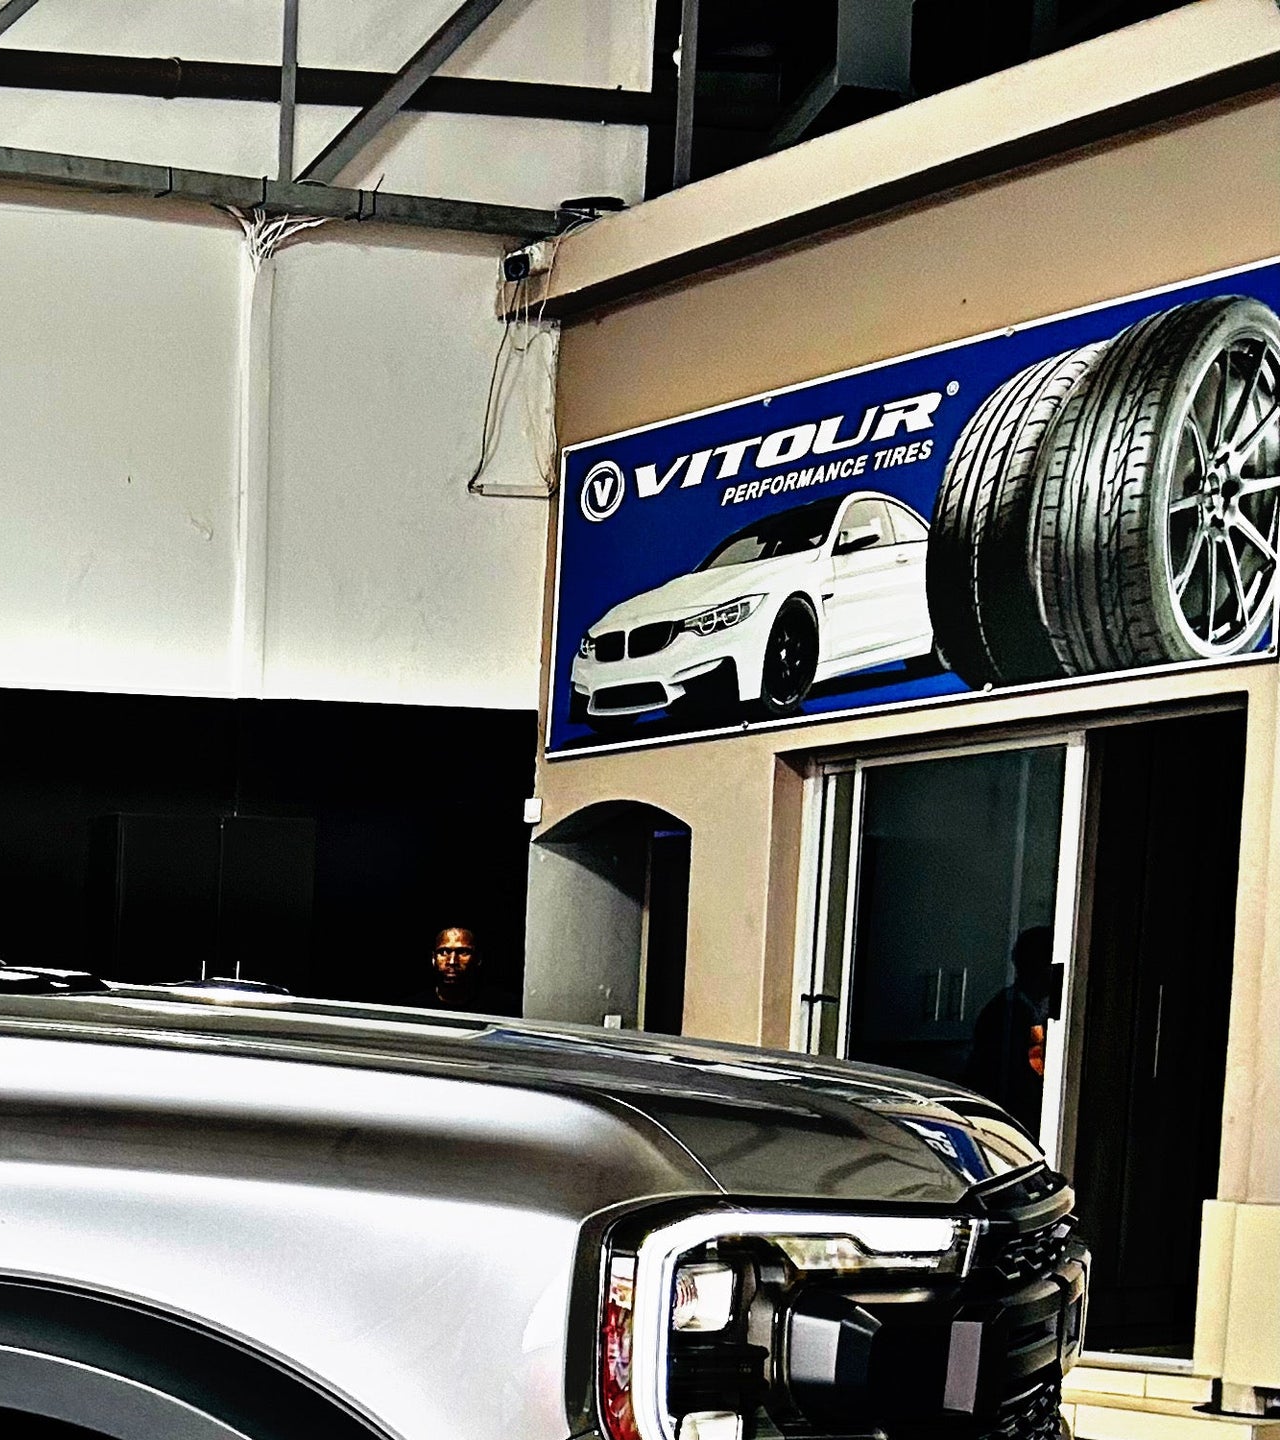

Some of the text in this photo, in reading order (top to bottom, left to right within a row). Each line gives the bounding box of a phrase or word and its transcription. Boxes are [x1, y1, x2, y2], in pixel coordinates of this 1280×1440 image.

[634, 391, 943, 499] VITOUR
[721, 439, 934, 507] PERFORMANCE TIRES
